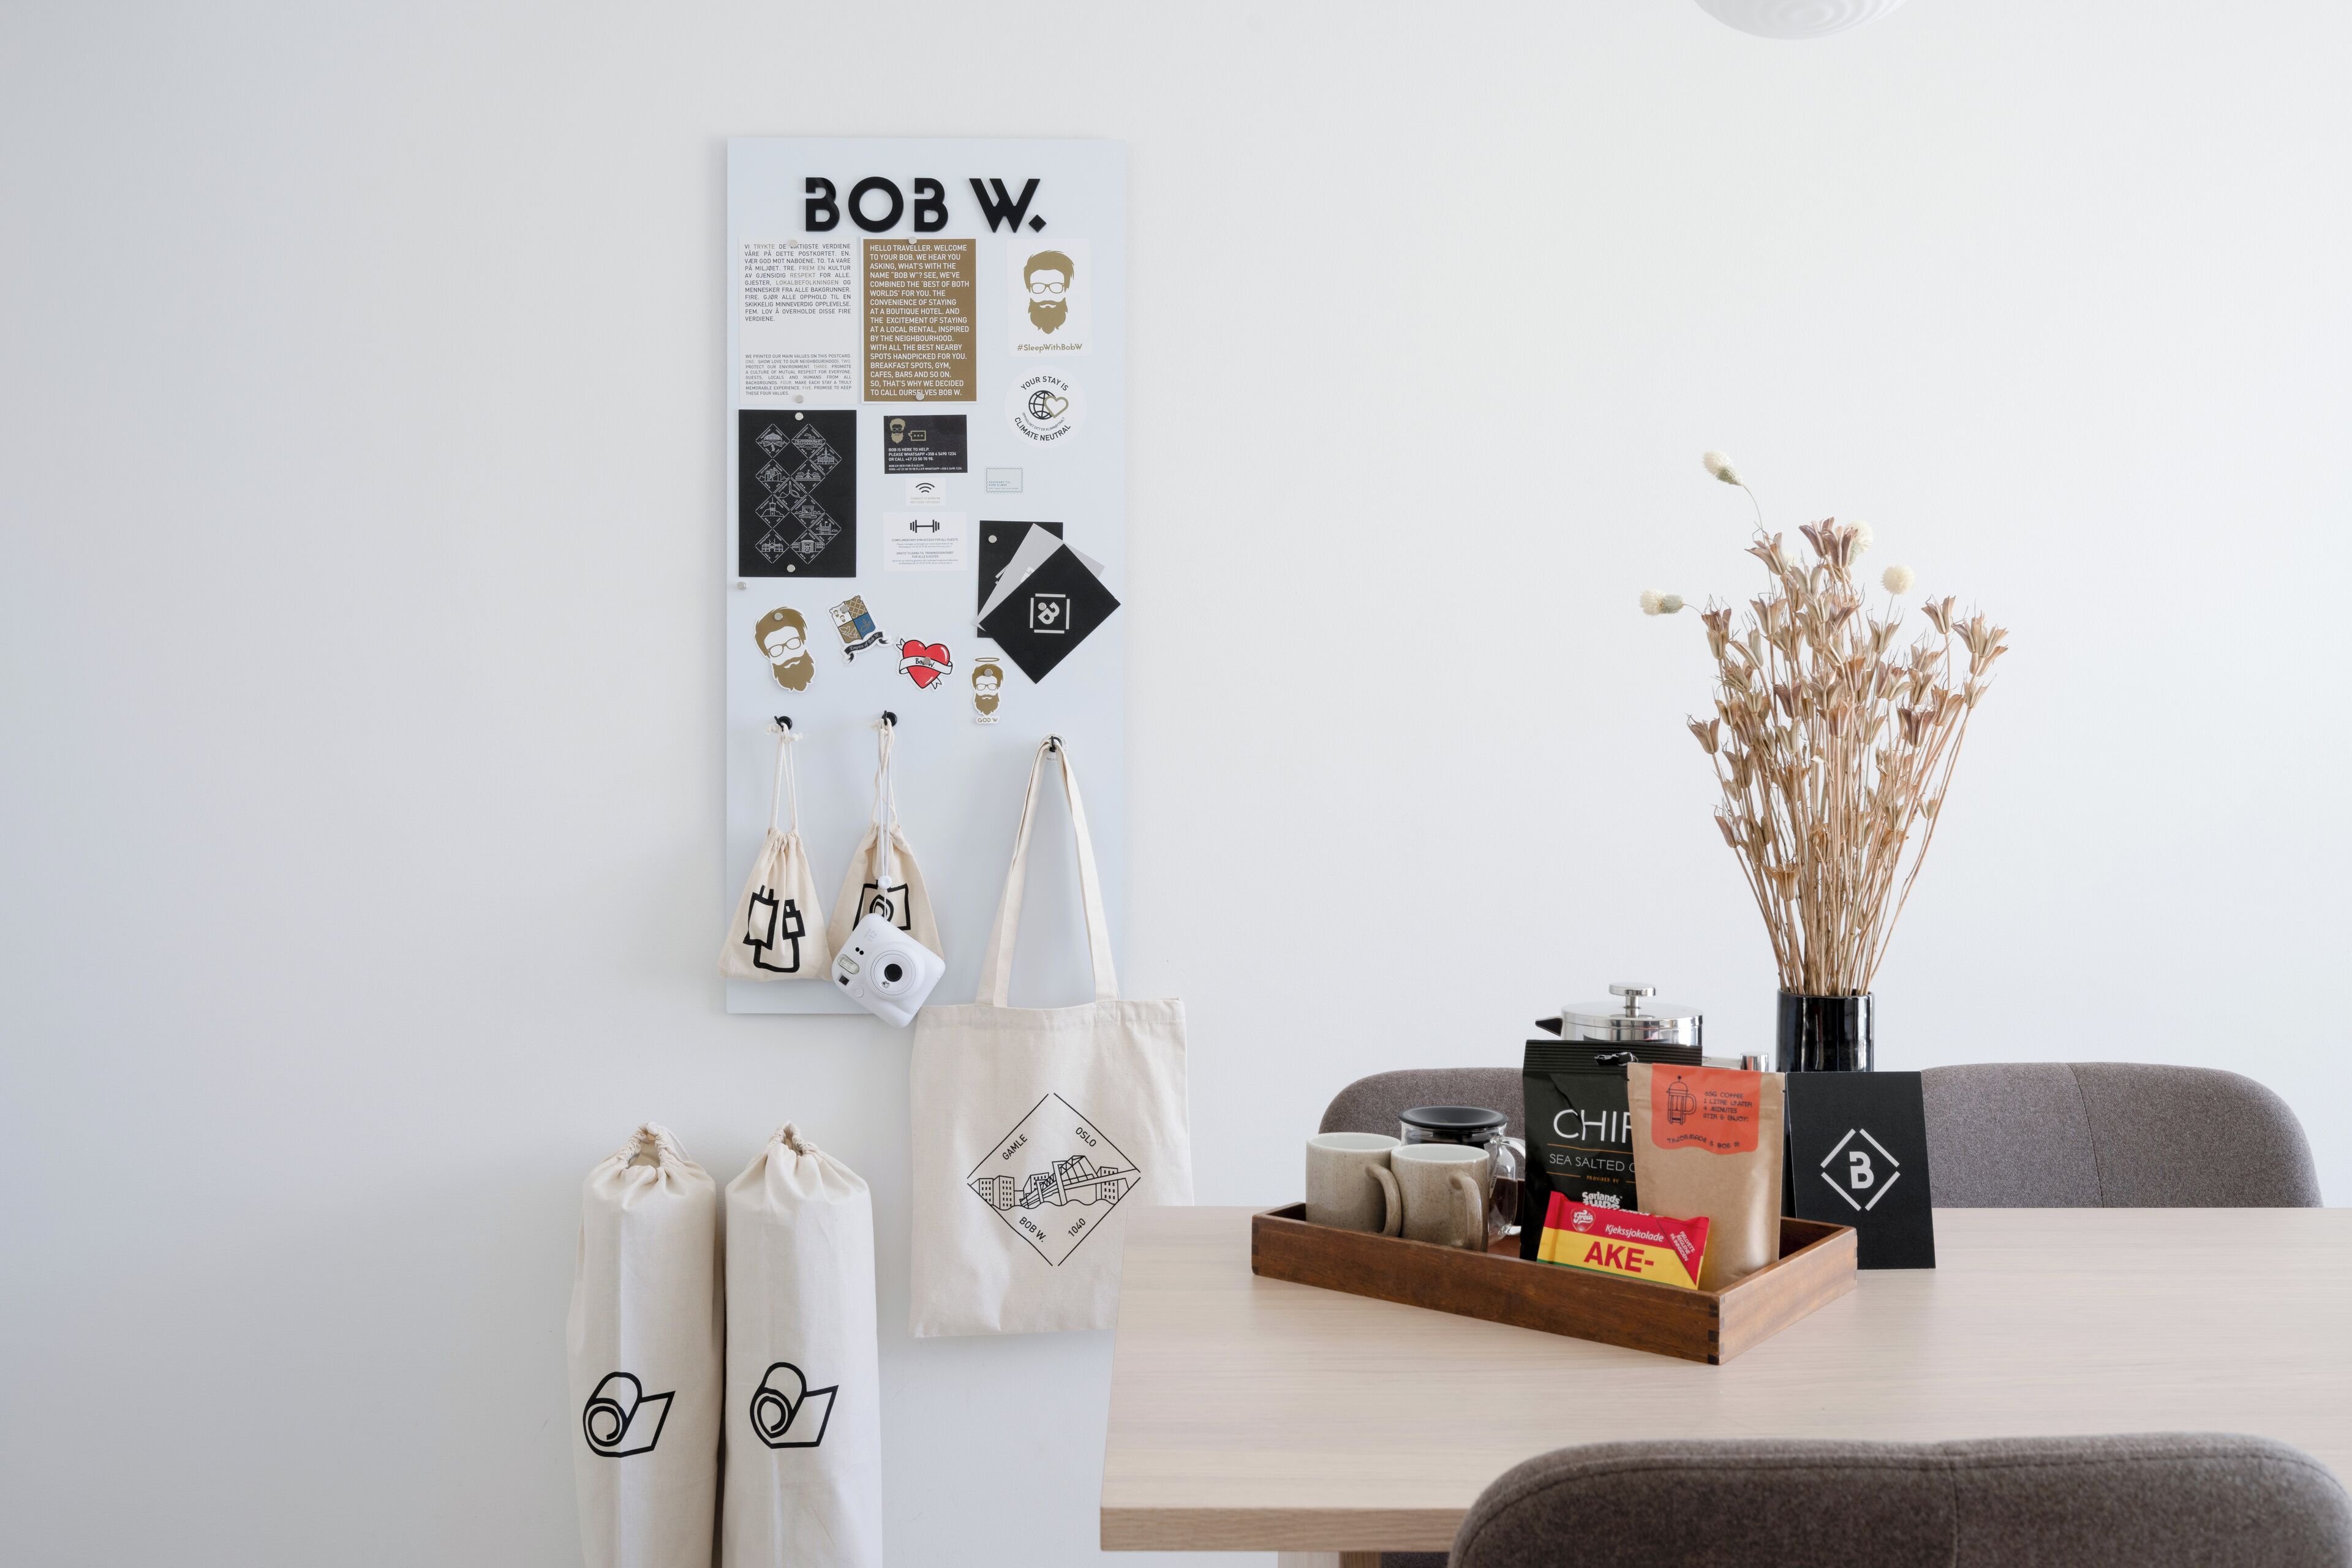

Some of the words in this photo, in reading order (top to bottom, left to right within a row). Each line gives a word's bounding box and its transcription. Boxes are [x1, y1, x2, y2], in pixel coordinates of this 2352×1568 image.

[805, 176, 949, 232] BOB
[969, 178, 1047, 233] W.
[1017, 343, 1083, 353] #SleepWithBobW
[1020, 377, 1041, 390] YOUR
[1042, 376, 1061, 385] STAY
[1015, 417, 1038, 440] CLIMATE
[1040, 424, 1071, 441] NEUTRAL
[1075, 1126, 1097, 1147] OSLO
[1001, 1134, 1028, 1161] GAMLE
[1550, 1153, 1572, 1165] SEA
[1575, 1157, 1625, 1171] SALTED
[1850, 1151, 1875, 1190] B
[1582, 1191, 1619, 1204] Sørlands
[1068, 1218, 1086, 1237] 1040
[1573, 1210, 1594, 1224] Freia
[1019, 1216, 1037, 1233] BOB
[1036, 1230, 1046, 1242] W.
[1605, 1224, 1664, 1242] Kjekssjokolade
[1673, 1239, 1689, 1261] INNSIDEN
[1676, 1234, 1691, 1254] REGLENE
[1679, 1231, 1695, 1253] FJELLVETT-
[1584, 1242, 1654, 1273] AKE-
